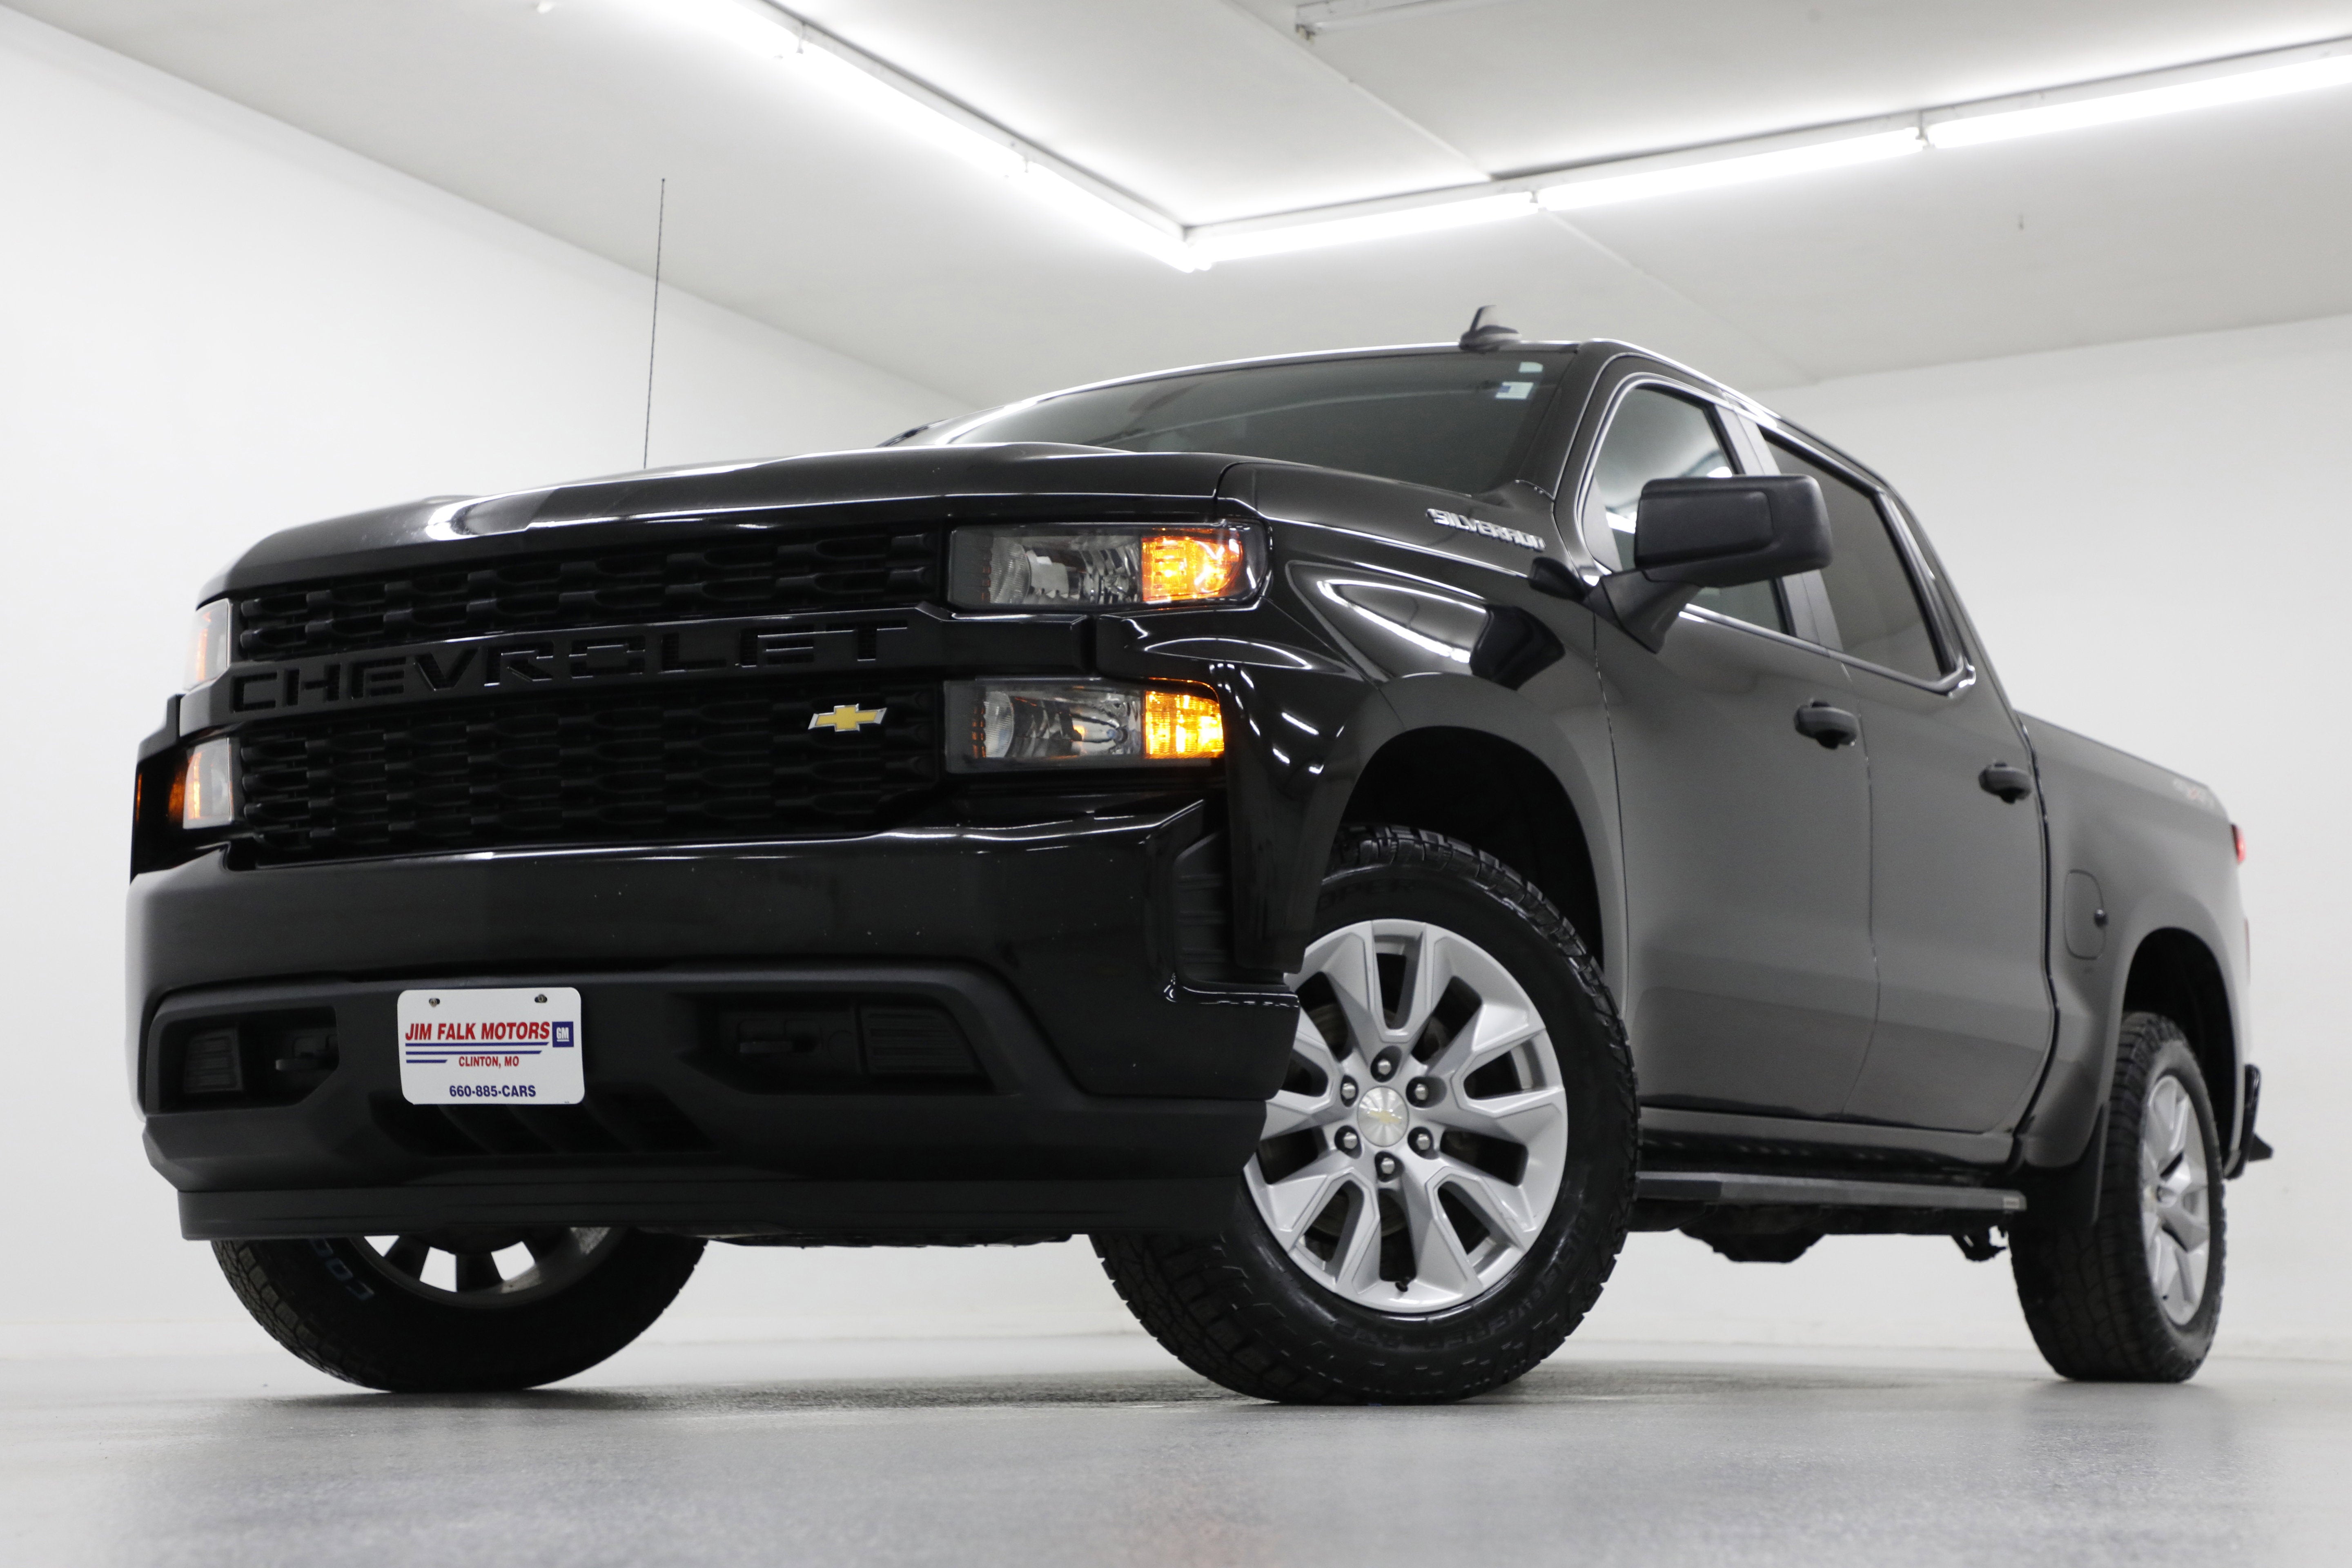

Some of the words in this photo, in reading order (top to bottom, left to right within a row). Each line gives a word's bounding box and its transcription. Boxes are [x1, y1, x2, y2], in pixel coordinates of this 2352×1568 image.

[1425, 508, 1546, 552] SILVERADO
[231, 619, 908, 713] CHEVROLET
[405, 1023, 432, 1040] JIM
[437, 1023, 476, 1040] FALK
[481, 1022, 550, 1040] MOTORS
[556, 1027, 569, 1039] GM
[459, 1056, 501, 1069] CLINTON,
[504, 1056, 519, 1067] MO
[449, 1085, 536, 1097] 660-885-CARS
